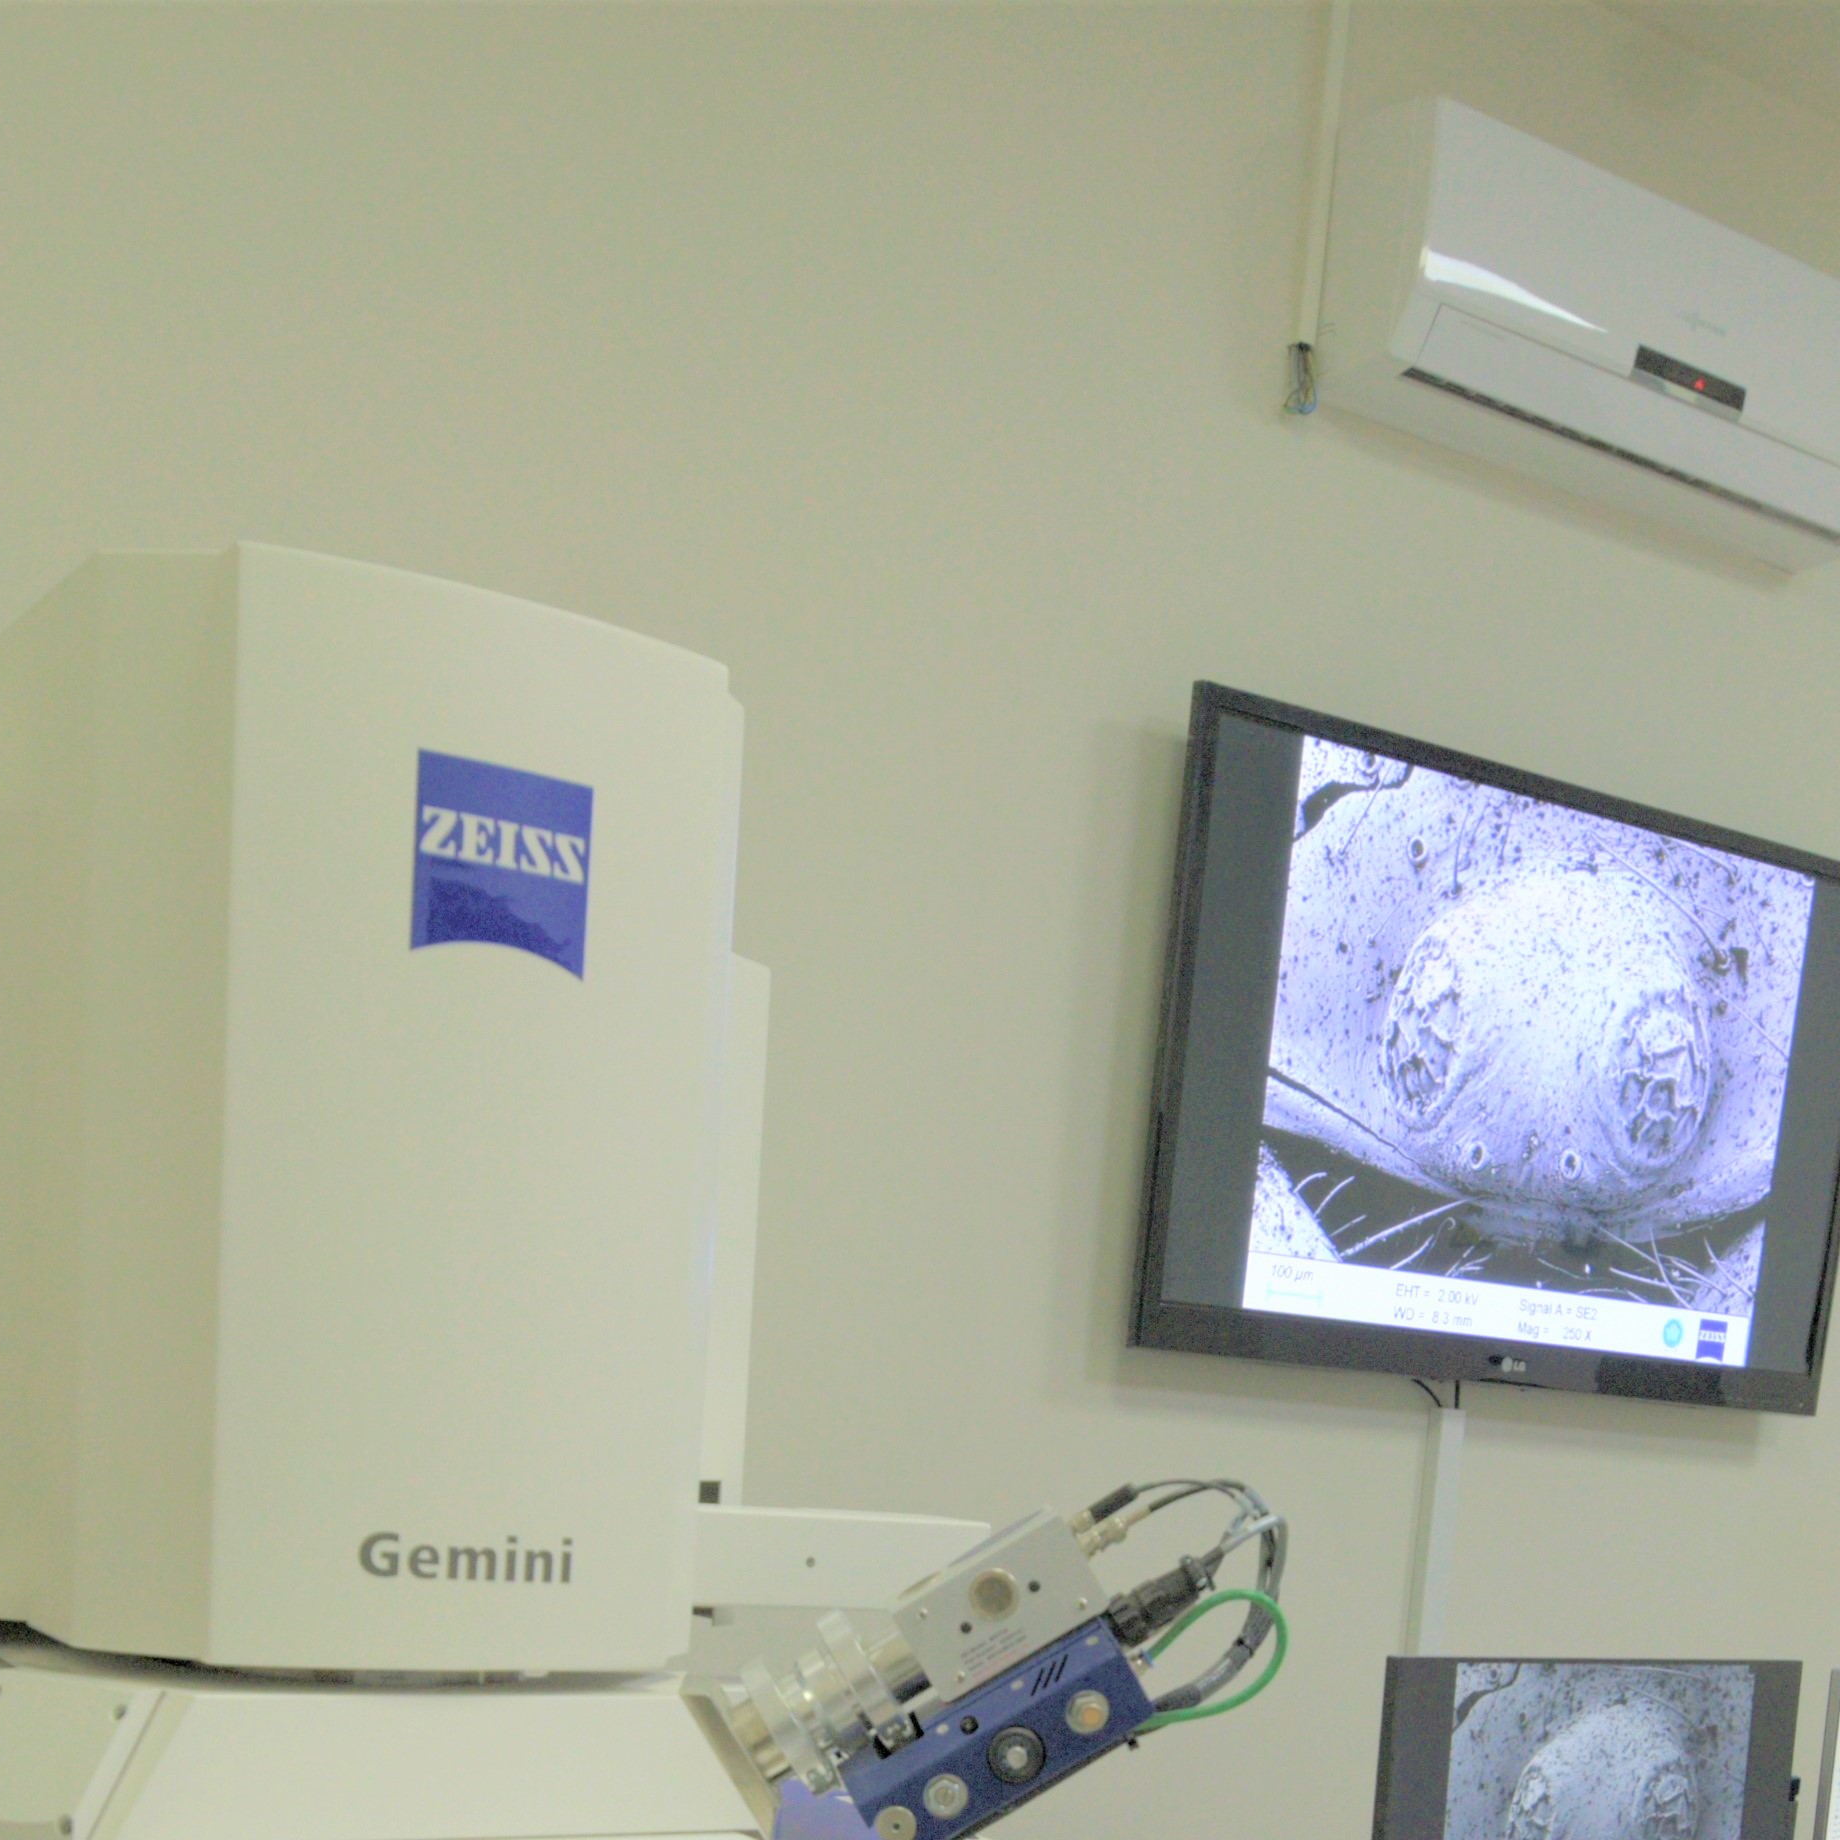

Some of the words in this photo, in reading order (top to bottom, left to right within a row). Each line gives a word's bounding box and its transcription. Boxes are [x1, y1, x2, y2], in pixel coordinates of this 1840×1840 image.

[419, 804, 586, 886] ZEISS
[1270, 1263, 1293, 1279] 100
[1395, 1283, 1421, 1299] EHT
[1464, 1292, 1480, 1307] kV
[1393, 1305, 1415, 1321] WD
[1452, 1314, 1473, 1328] mm
[1518, 1299, 1553, 1317] Signal
[1576, 1306, 1598, 1321] SE2
[1517, 1321, 1541, 1338] Mag
[1562, 1326, 1582, 1341] 250
[1512, 1360, 1527, 1372] LG
[357, 1531, 573, 1583] Gemini
